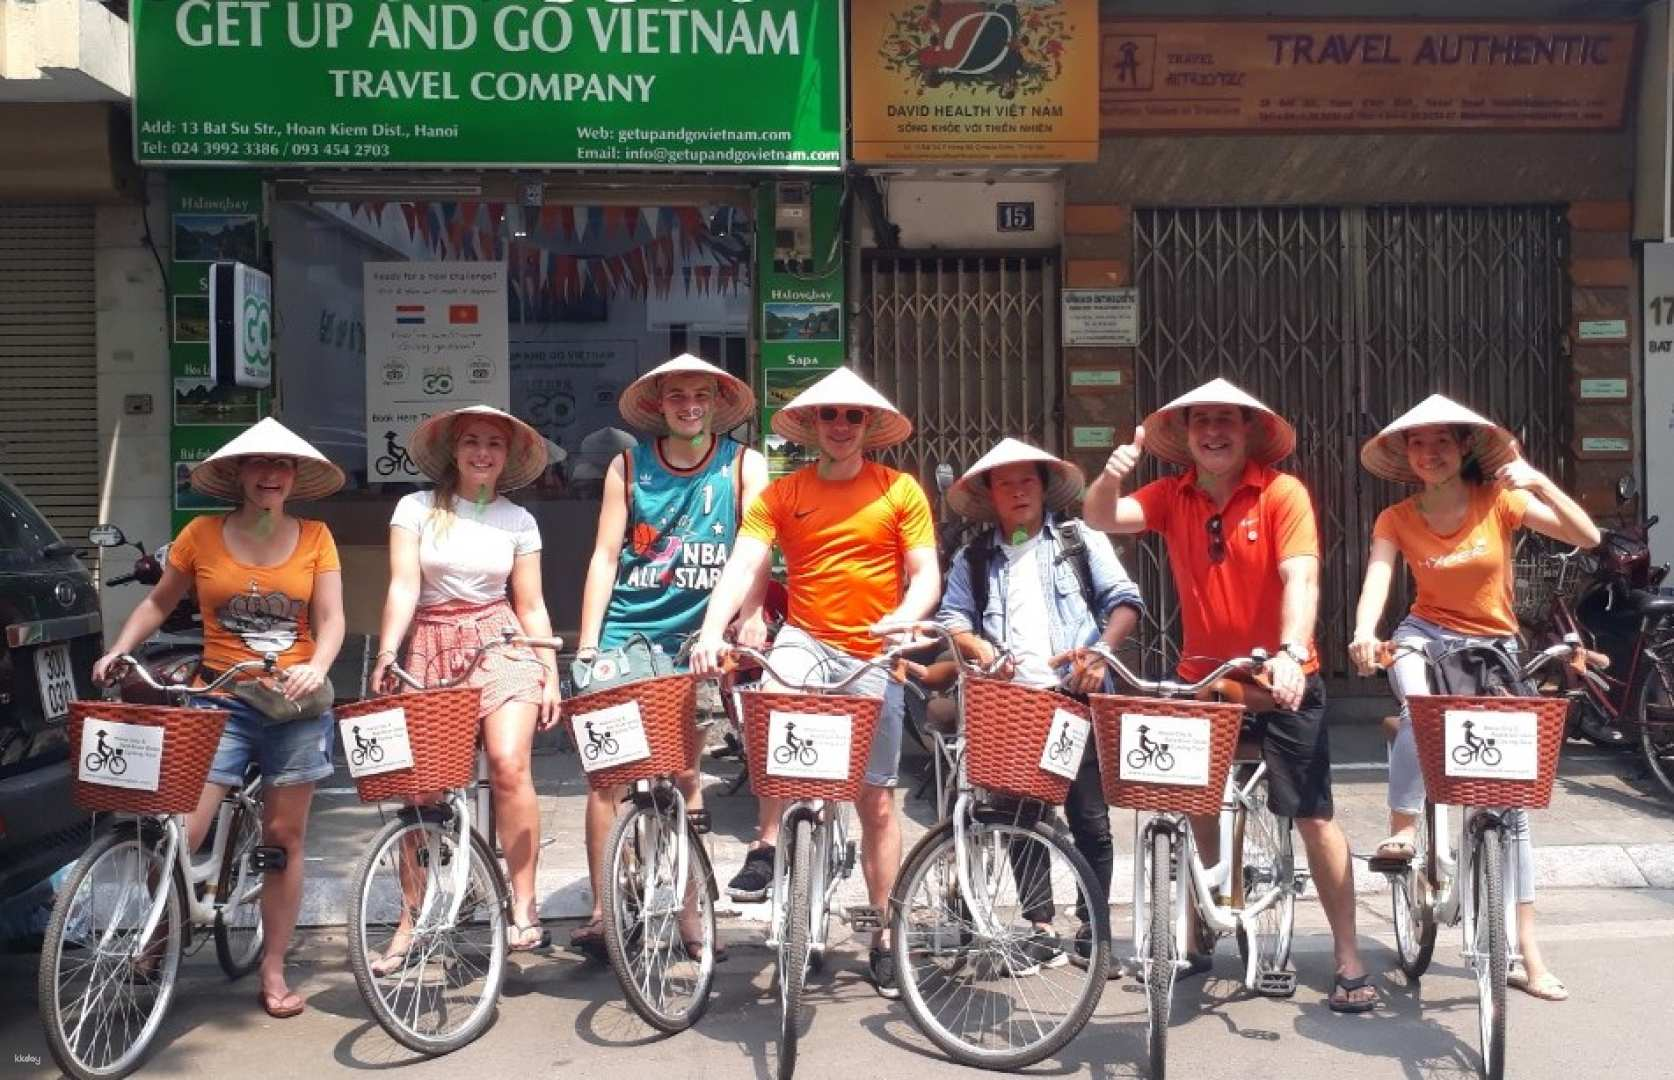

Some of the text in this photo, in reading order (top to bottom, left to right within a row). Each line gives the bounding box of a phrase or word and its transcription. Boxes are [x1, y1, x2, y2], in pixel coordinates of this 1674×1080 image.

[175, 0, 801, 56] GET UP AND GO VIETNAM
[1266, 33, 1614, 66] TRAVEL AUTHENTIC
[328, 70, 656, 103] TRAVEL COMPANY
[887, 104, 930, 118] DAVID
[934, 104, 991, 118] HEALTH
[1031, 104, 1063, 118] NAM
[141, 121, 176, 135] Add:
[181, 122, 198, 135] 13
[203, 122, 227, 136] Bat
[231, 122, 249, 136] Su
[253, 122, 281, 138] Str.,
[286, 123, 326, 137] Hoan
[330, 123, 368, 138] Kiem
[414, 124, 459, 139] Hanoi
[576, 126, 792, 145] Web: getupandgovietnam.com
[142, 141, 167, 155] Tel:
[171, 142, 199, 155] 024
[203, 142, 239, 155] 3992
[291, 143, 319, 156] 093
[323, 143, 350, 156] 454
[576, 147, 841, 163] Email: info@getupandgovietnam.com
[1004, 208, 1027, 229] 15
[787, 354, 819, 368] Sapa
[682, 542, 729, 567] NBA
[627, 566, 722, 590] ALL STAR
